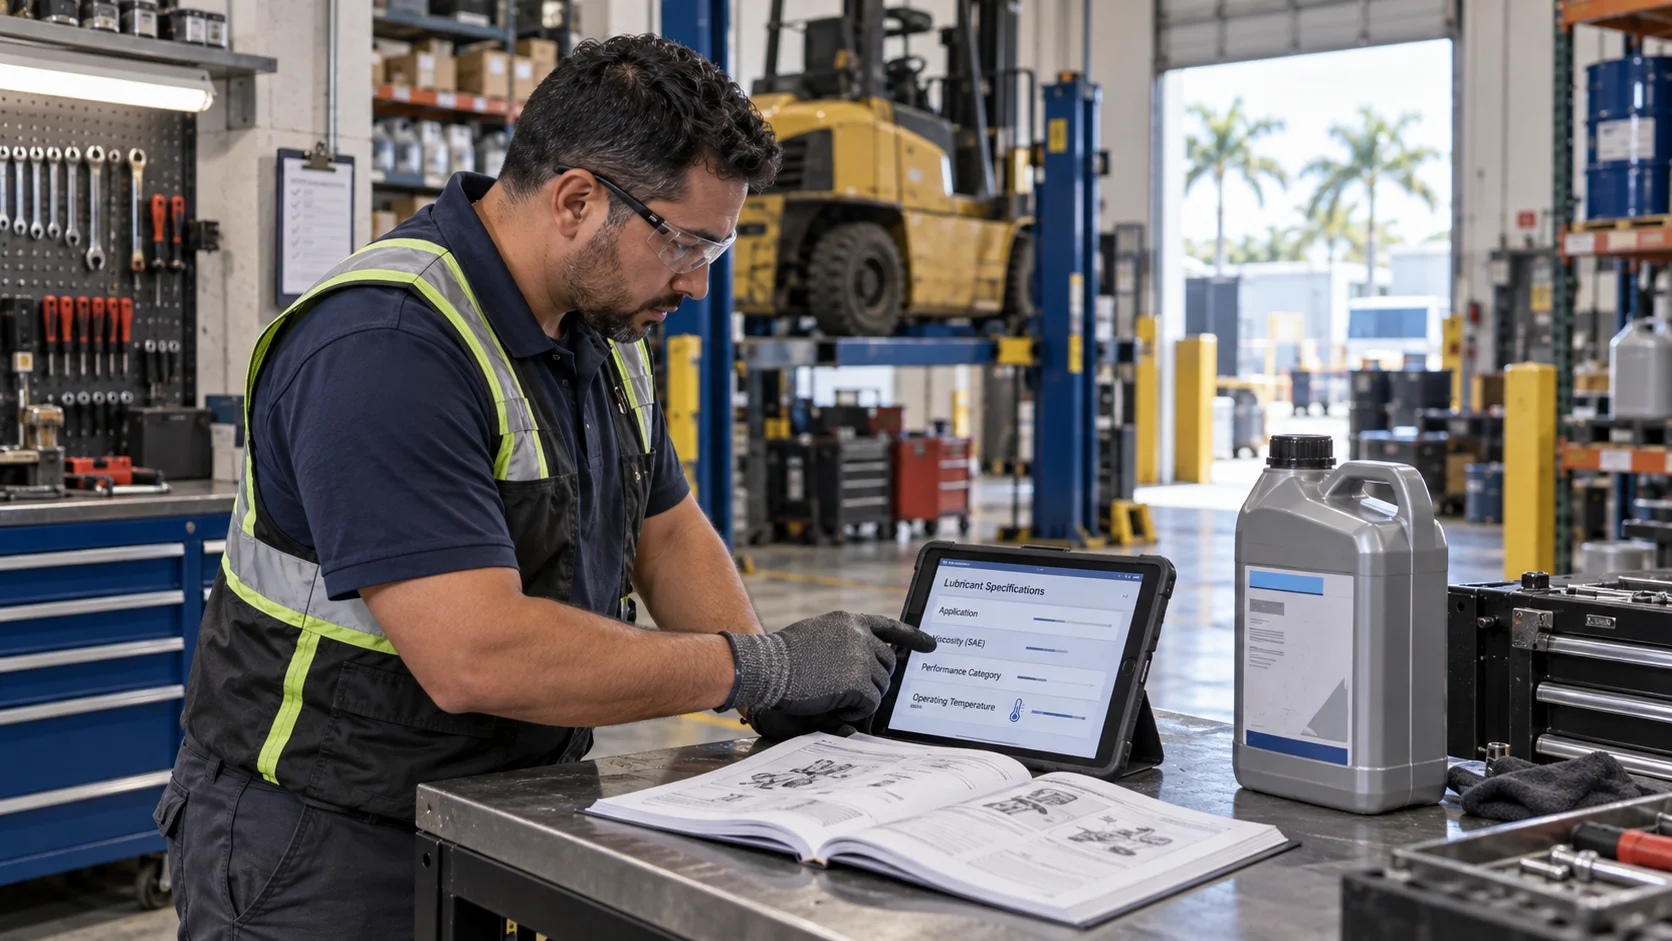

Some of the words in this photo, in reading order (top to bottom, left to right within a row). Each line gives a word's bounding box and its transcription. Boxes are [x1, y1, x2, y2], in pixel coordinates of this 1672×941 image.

[944, 578, 983, 591] Lubricant
[985, 581, 1045, 596] Specifications
[939, 606, 978, 618] Application
[964, 638, 986, 649] (SAE)
[921, 663, 967, 676] Performance
[968, 668, 1001, 681] Category
[912, 693, 948, 707] Operating
[950, 697, 996, 711] Temperature
